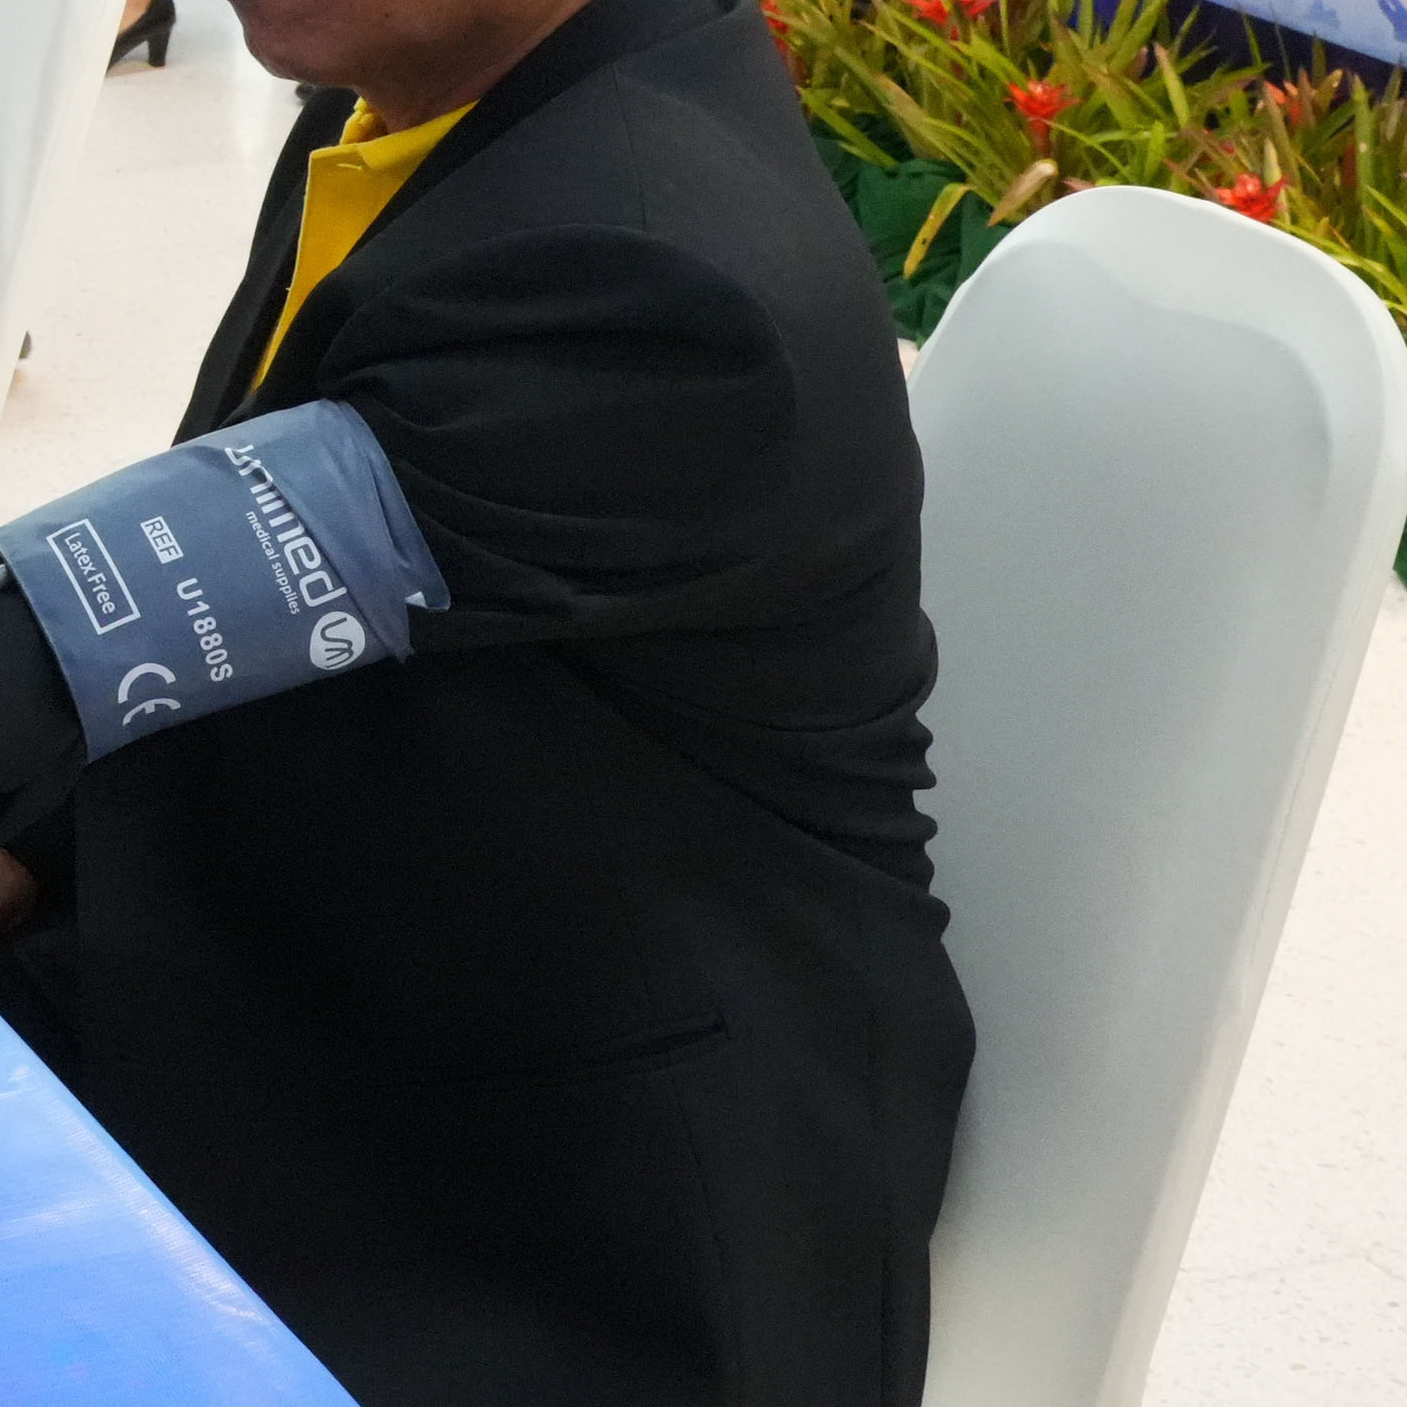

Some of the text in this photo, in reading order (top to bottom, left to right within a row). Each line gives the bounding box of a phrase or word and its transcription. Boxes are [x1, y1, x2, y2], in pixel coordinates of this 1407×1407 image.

[64, 532, 116, 615] Latex Free
[144, 518, 180, 562] REF
[245, 510, 300, 615] medical supplies
[177, 577, 234, 683] U1880S
[117, 662, 182, 727] CE
